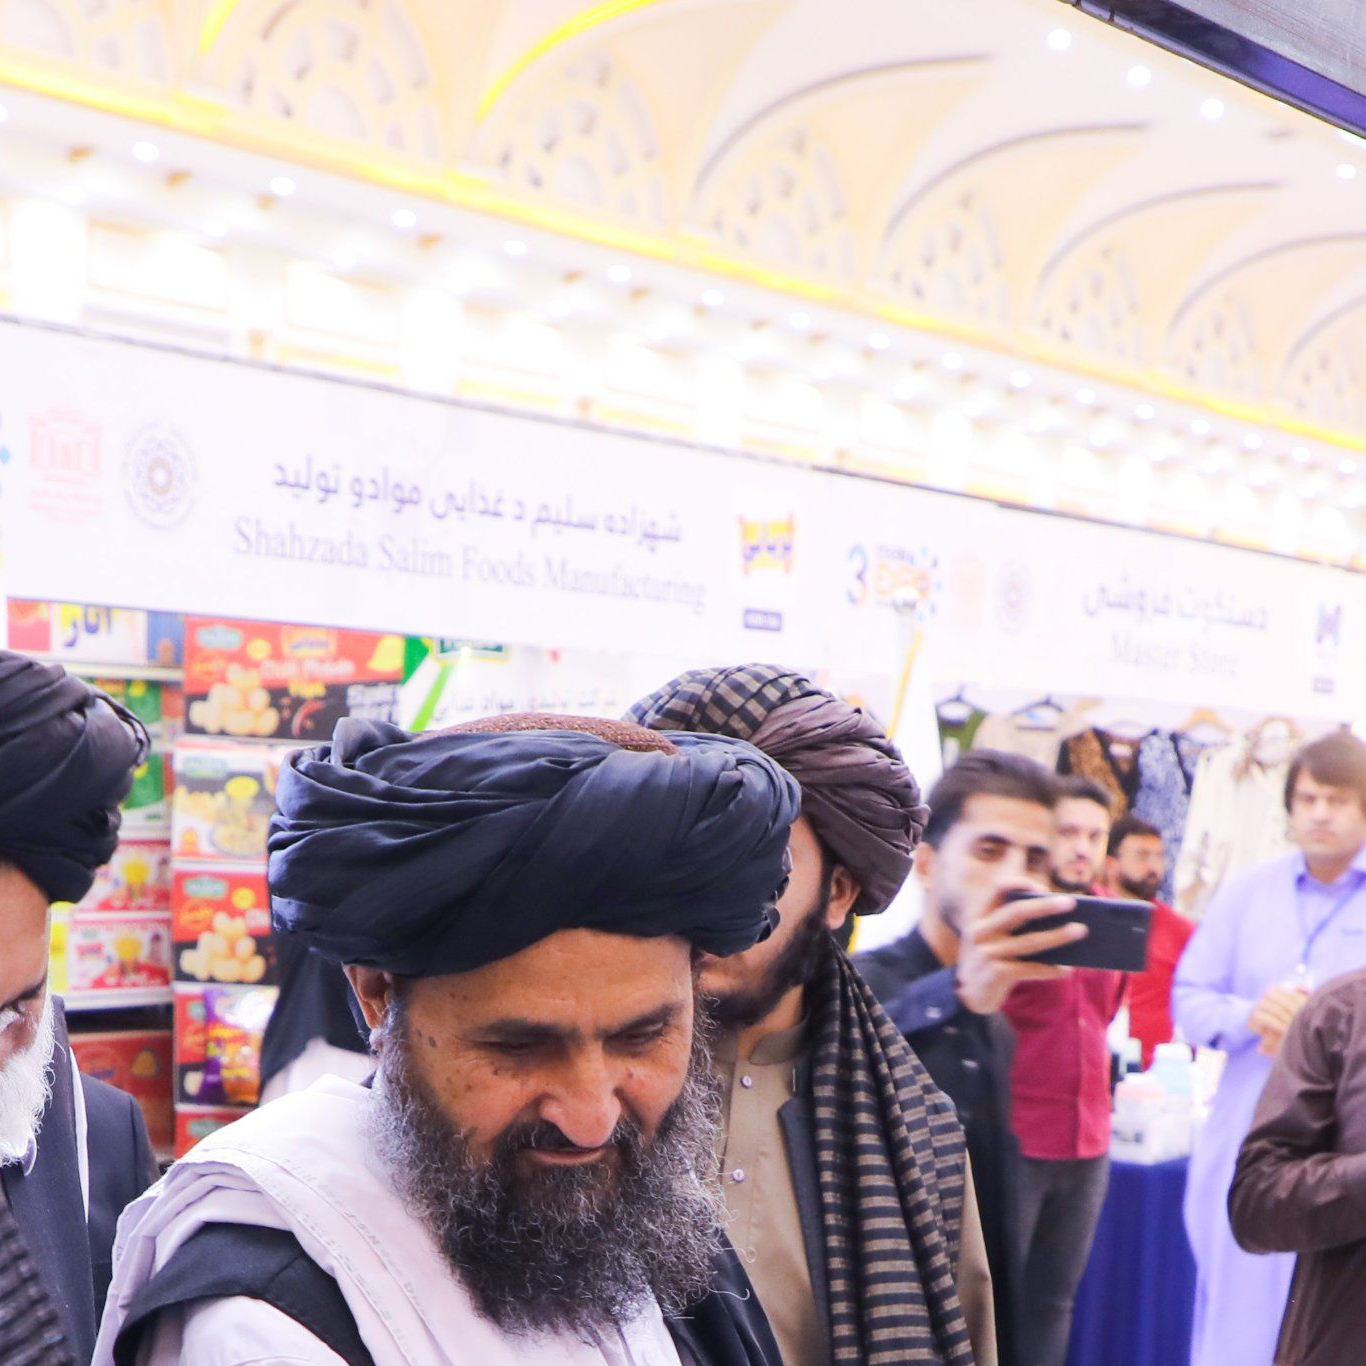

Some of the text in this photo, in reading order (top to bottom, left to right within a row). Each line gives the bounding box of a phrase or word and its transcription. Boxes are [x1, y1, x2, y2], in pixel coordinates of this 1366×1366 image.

[232, 514, 371, 568] Shahzada
[377, 532, 454, 580] Salim
[461, 543, 538, 589] Foods
